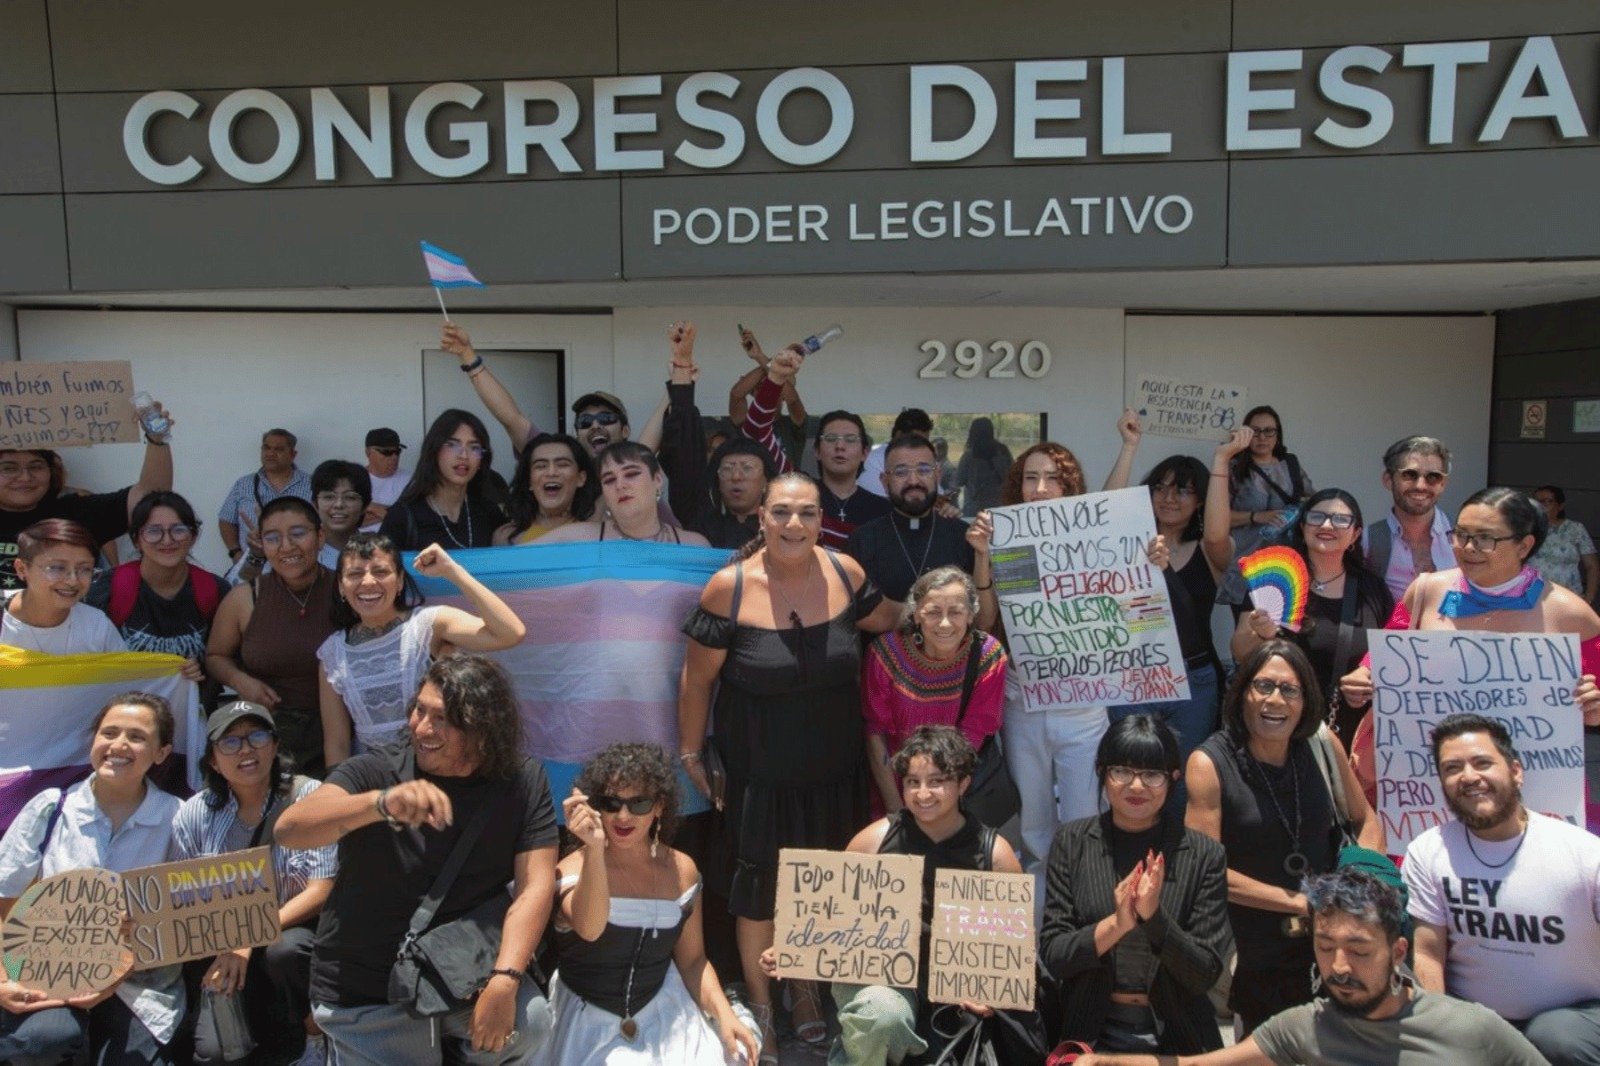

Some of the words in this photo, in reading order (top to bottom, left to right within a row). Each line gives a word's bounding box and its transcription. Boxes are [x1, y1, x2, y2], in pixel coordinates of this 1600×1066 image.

[123, 67, 854, 185] CONGRESO
[910, 57, 1172, 162] DEL
[1226, 36, 1589, 151] ESTA
[653, 205, 829, 245] PODER
[849, 195, 1193, 241] LEGISLATIVO
[919, 340, 1051, 379] 2920
[1210, 388, 1225, 400] LA
[989, 504, 1070, 547] DICEN
[1073, 498, 1110, 530] QUE
[1039, 536, 1118, 573] SOMOS
[1120, 531, 1151, 566] UN
[1040, 563, 1153, 600] PELIGRO!!!
[1002, 599, 1051, 629] POR
[1048, 596, 1123, 627] NUESTRA
[1019, 657, 1071, 680] PERO
[1071, 652, 1101, 676] LOS
[1103, 643, 1170, 674] PEORES
[1379, 634, 1444, 686] SE
[1450, 636, 1579, 684] DICEN
[1023, 676, 1121, 708] MONSTRUOS
[1376, 686, 1527, 715] DEFENSORES
[1543, 687, 1573, 707] de
[1377, 717, 1402, 747] LA
[1380, 751, 1393, 776] Y
[1520, 745, 1584, 771] UMANOS
[1379, 779, 1435, 808] PERO
[30, 877, 126, 911] MUNDOS
[124, 873, 163, 918] NO
[786, 862, 833, 893] TODO
[842, 860, 905, 900] MUNDO
[952, 875, 1032, 903] NIÑECES
[1442, 876, 1502, 908] LEY
[65, 904, 120, 928] VIVOS
[793, 895, 844, 920] TIENE
[859, 892, 899, 922] UNA
[939, 902, 1031, 939] TRANS
[32, 924, 123, 947] EXISTEN
[173, 901, 278, 958] DERECHOS
[786, 918, 911, 950] identidad
[1448, 906, 1565, 945] TRANS
[934, 939, 1021, 970] EXISTEN
[19, 959, 112, 990] BINARIO
[934, 970, 1030, 1004] IMPORTAN
